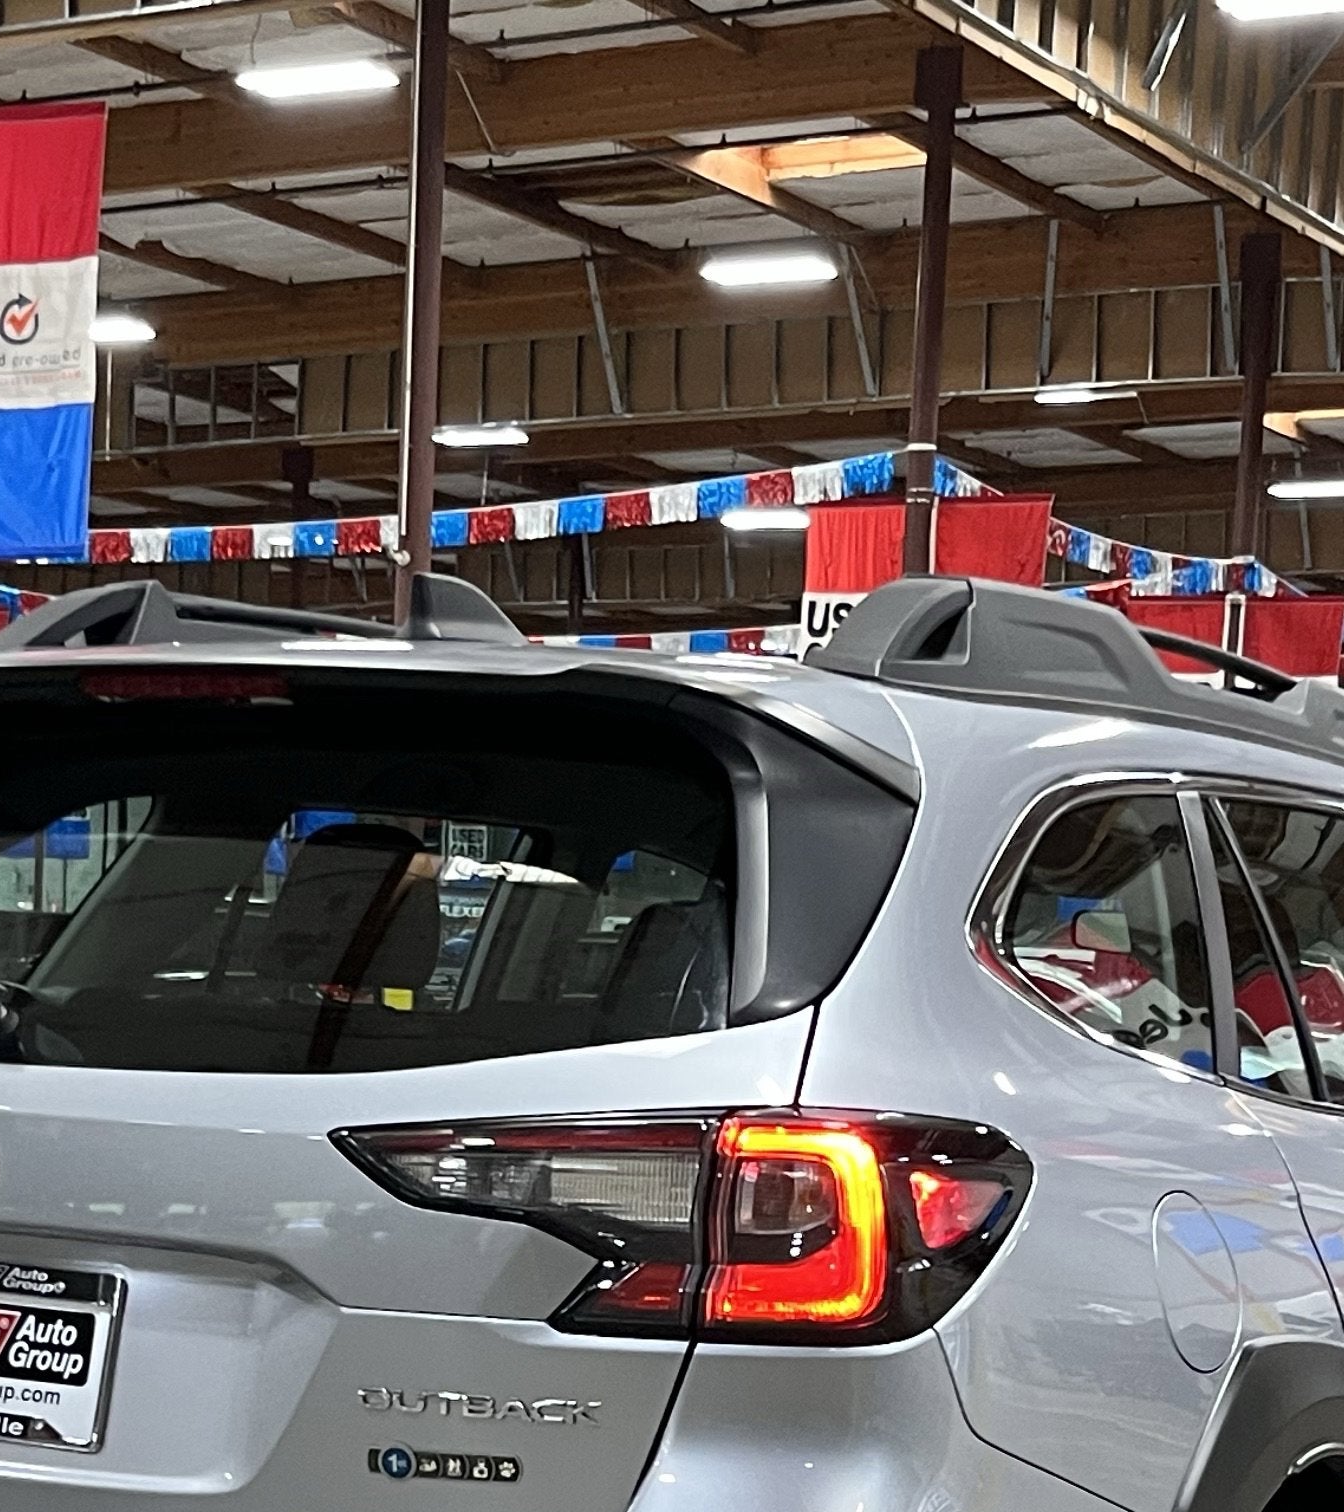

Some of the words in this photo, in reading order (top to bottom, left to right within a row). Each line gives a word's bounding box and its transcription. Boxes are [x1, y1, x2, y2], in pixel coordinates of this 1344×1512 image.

[12, 346, 81, 369] pre-owed
[6, 1267, 49, 1282] Auto
[16, 1314, 78, 1346] Auto
[8, 1341, 84, 1380] Group
[356, 1386, 603, 1428] OUTBACK
